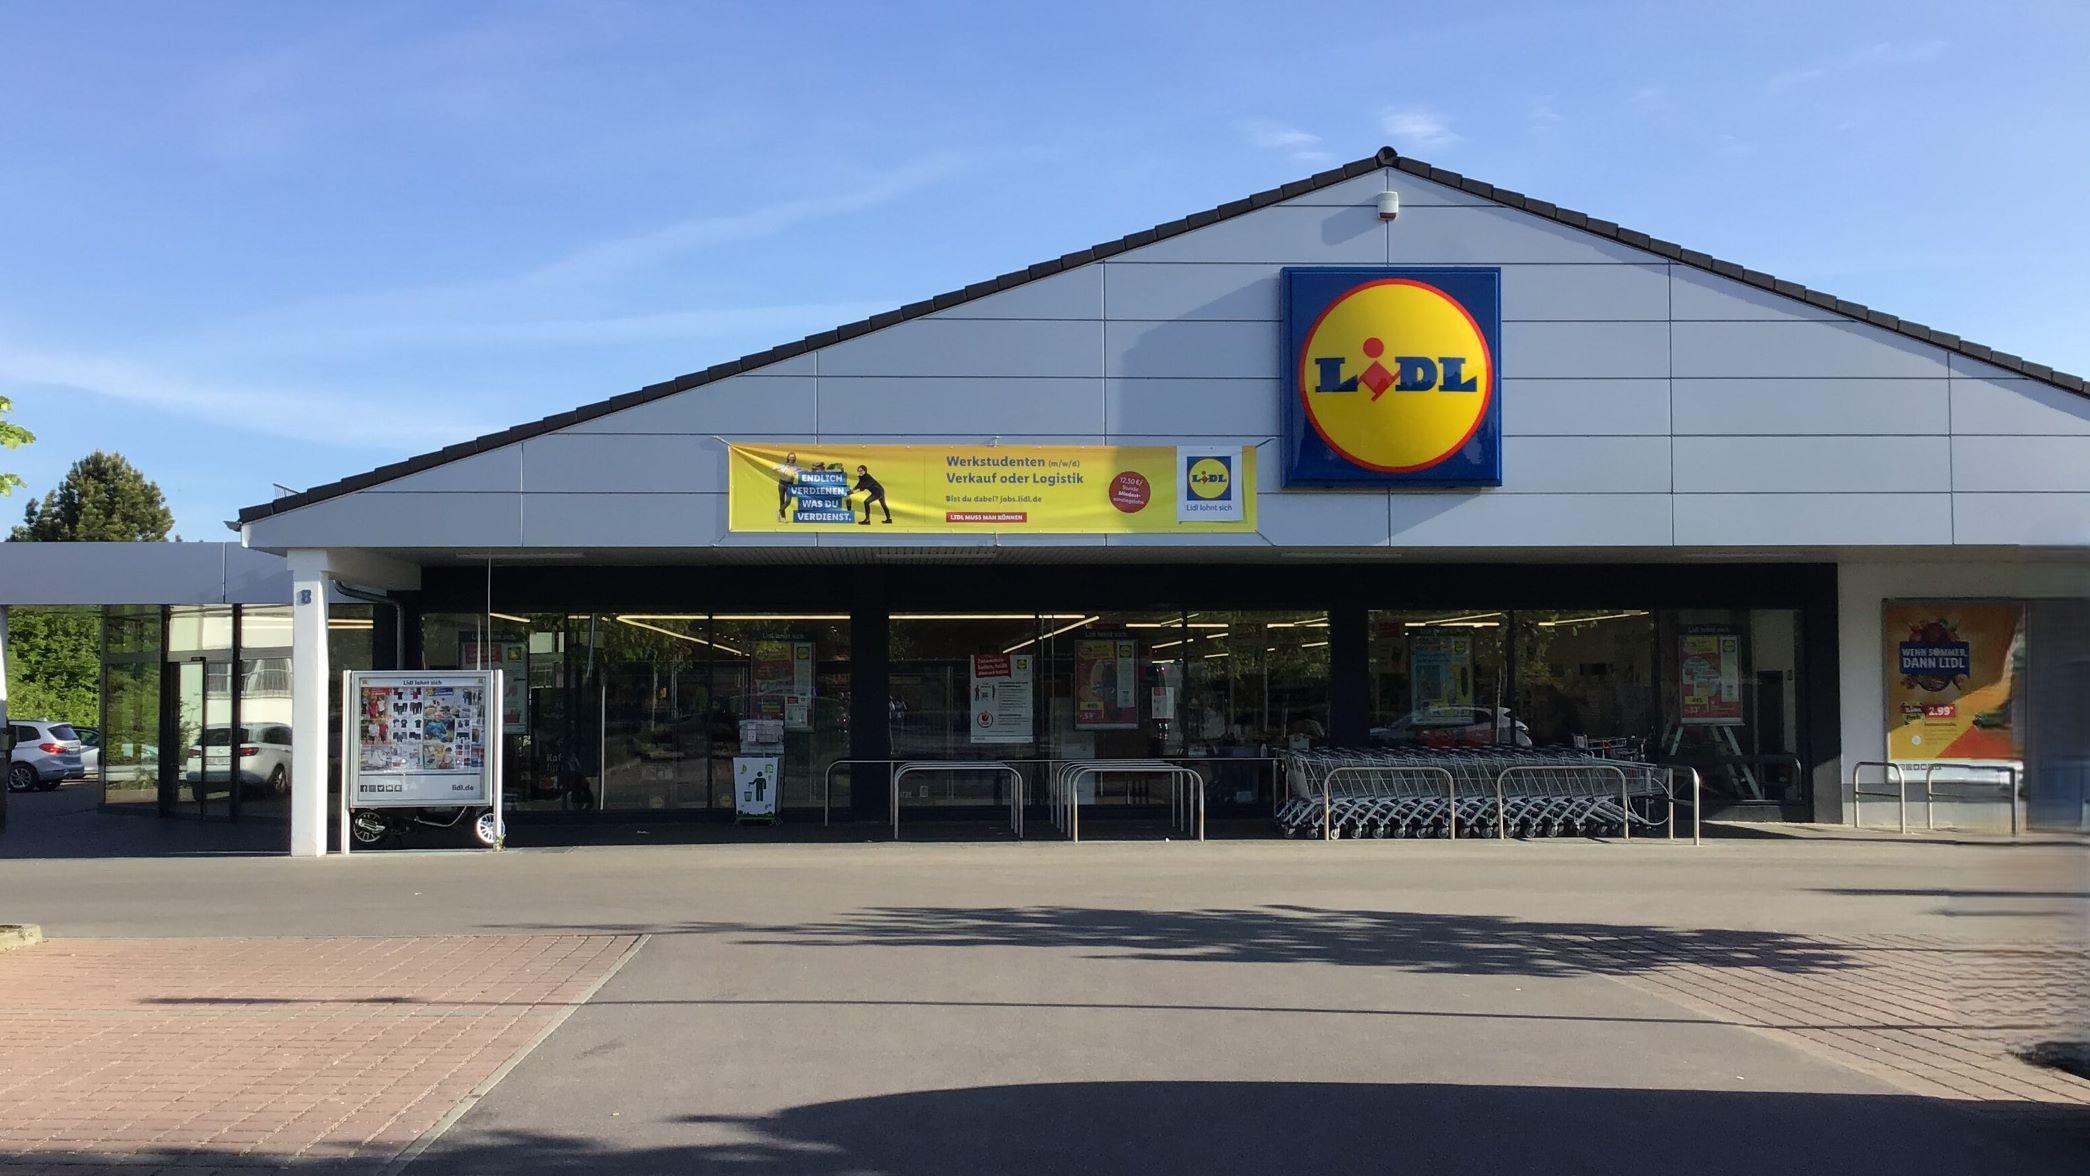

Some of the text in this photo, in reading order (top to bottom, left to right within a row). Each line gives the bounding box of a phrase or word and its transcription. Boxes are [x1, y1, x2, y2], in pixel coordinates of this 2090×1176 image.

[946, 455, 1080, 469] Werkstudenten (m/w/d)
[801, 474, 843, 482] ENDLICH
[946, 472, 1084, 487] Verkauf oder Logistik
[790, 486, 848, 497] VERDIENEN,
[802, 499, 839, 508] WAS DU
[945, 495, 1042, 504] Bist du dabei? jobs.lidl.de
[1186, 504, 1233, 512] Lidl lohnt sich
[797, 512, 852, 521] VERDIENST.
[950, 513, 964, 521] LIDL
[965, 513, 982, 521] MUSS
[983, 513, 997, 521] MAN
[1901, 648, 1927, 657] WENN
[1903, 657, 1966, 669] DANN LIDL
